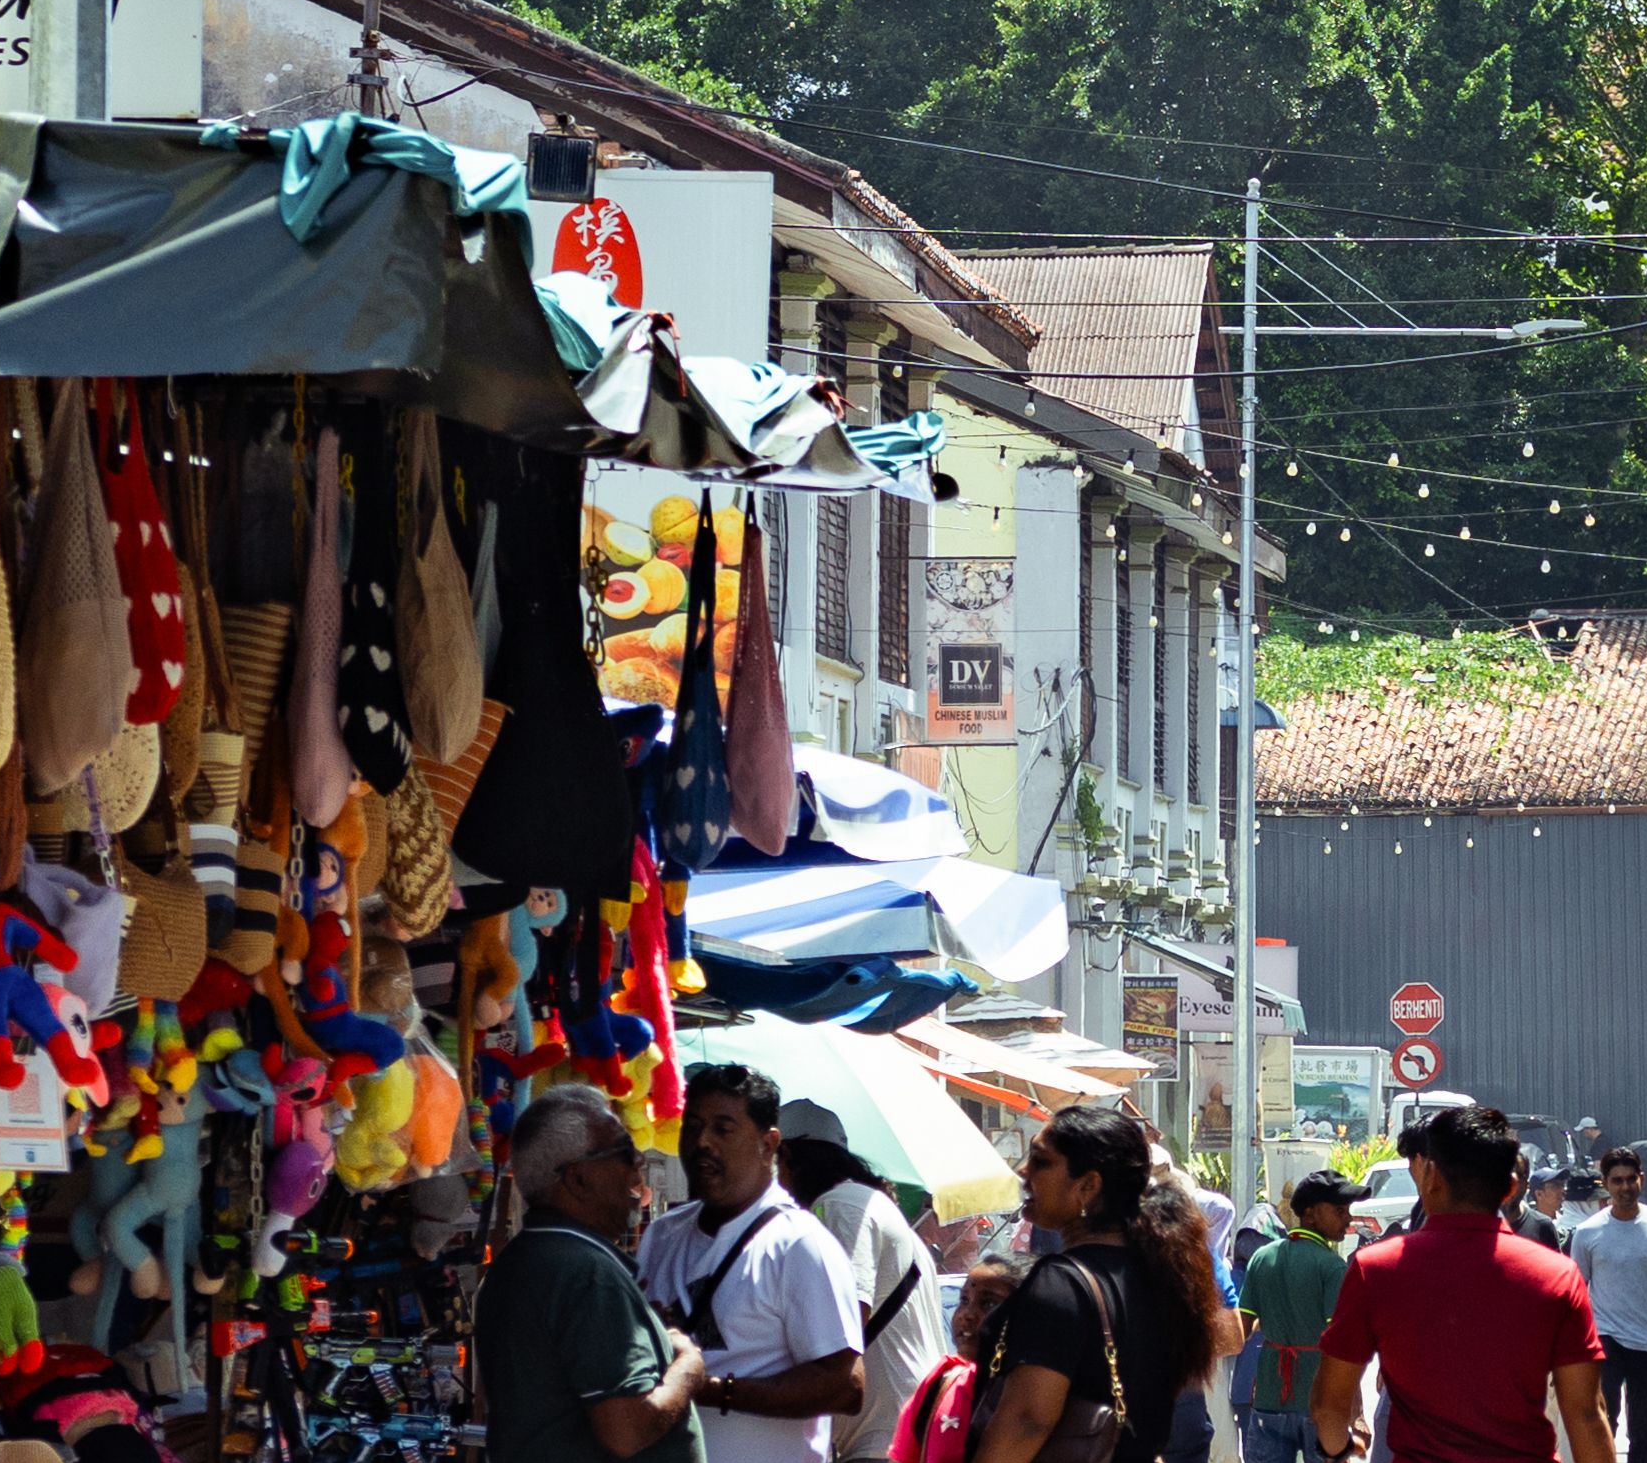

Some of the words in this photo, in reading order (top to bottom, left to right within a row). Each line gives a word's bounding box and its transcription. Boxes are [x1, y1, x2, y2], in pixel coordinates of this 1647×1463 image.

[948, 659, 993, 687] DV
[934, 710, 972, 721] CHINESE
[974, 709, 1008, 720] MUSLIM
[959, 723, 983, 734] FOOD
[1393, 999, 1442, 1020] BERHENTI
